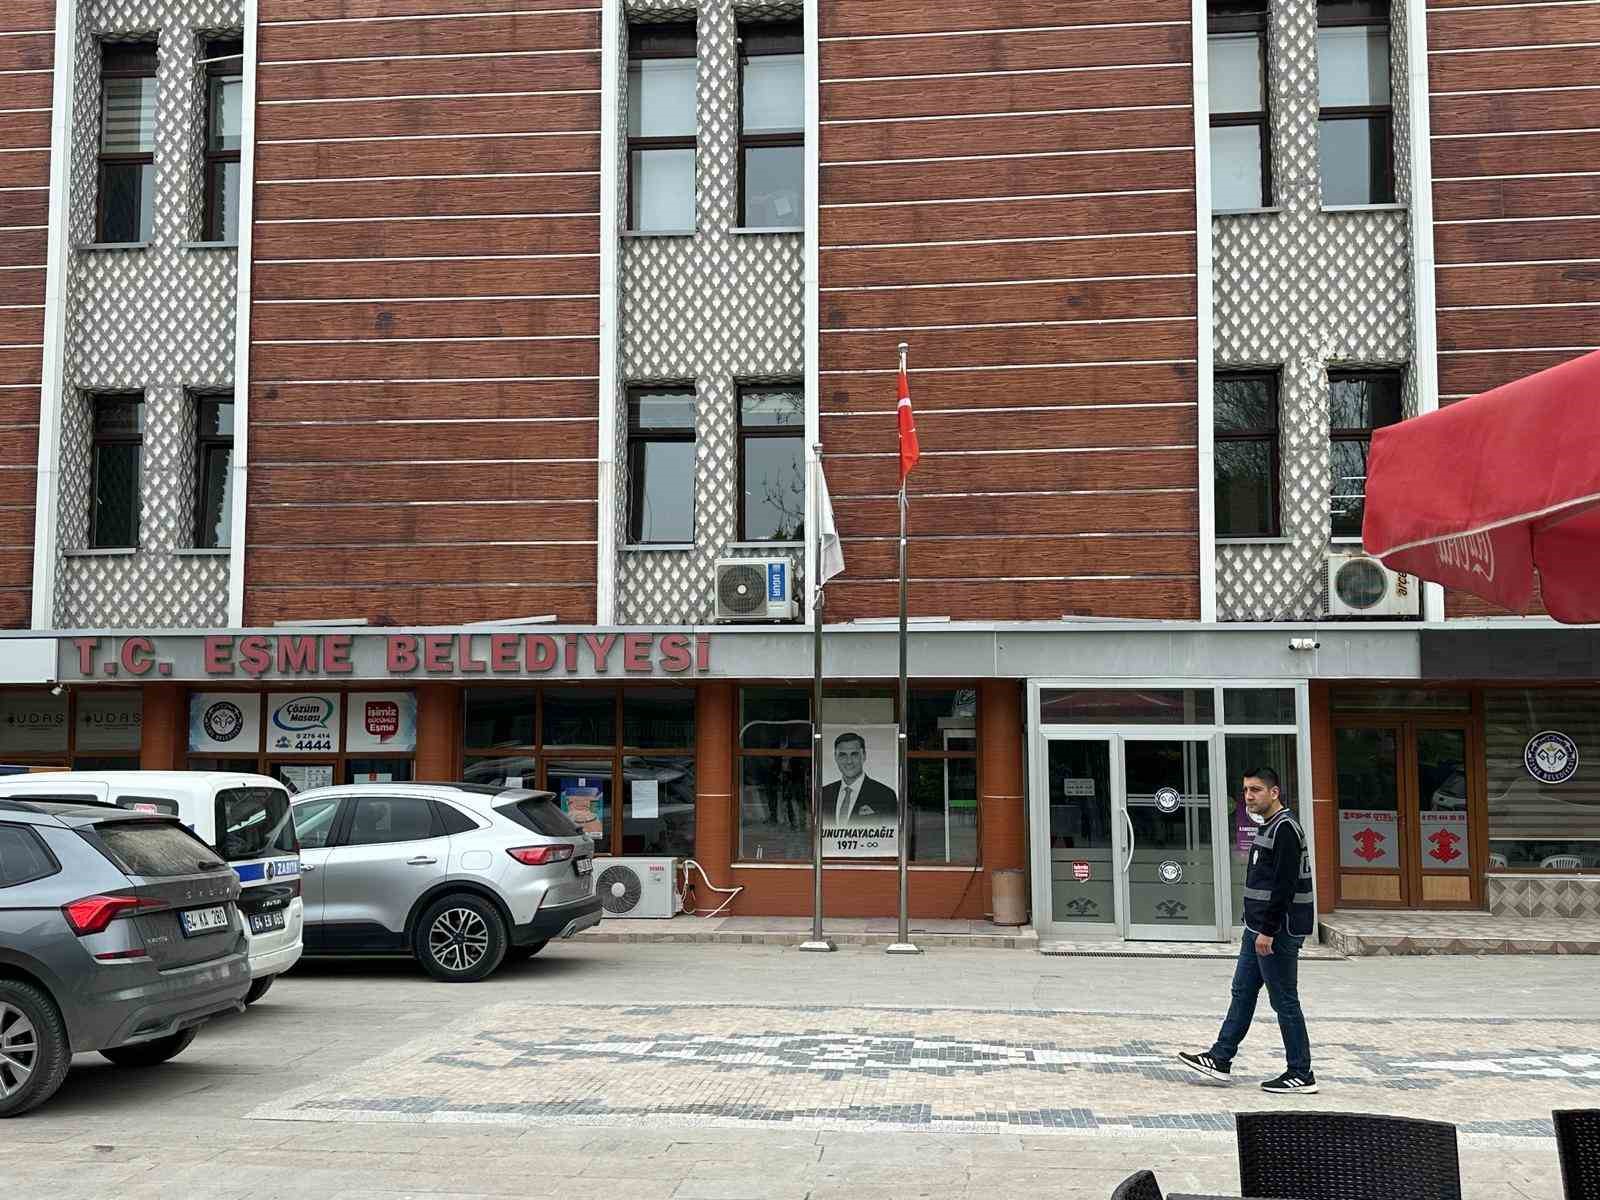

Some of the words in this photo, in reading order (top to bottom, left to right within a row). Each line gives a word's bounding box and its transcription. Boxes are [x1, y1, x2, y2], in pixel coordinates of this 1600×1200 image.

[73, 635, 172, 676] T.C.
[203, 635, 354, 679] EŞME
[286, 703, 320, 715] Çözüm
[289, 713, 321, 723] Masası
[369, 724, 395, 733] Eşme
[295, 740, 332, 751] 4444
[820, 825, 895, 839] UNUTMAYACAĞIZ
[837, 841, 858, 851] 1977
